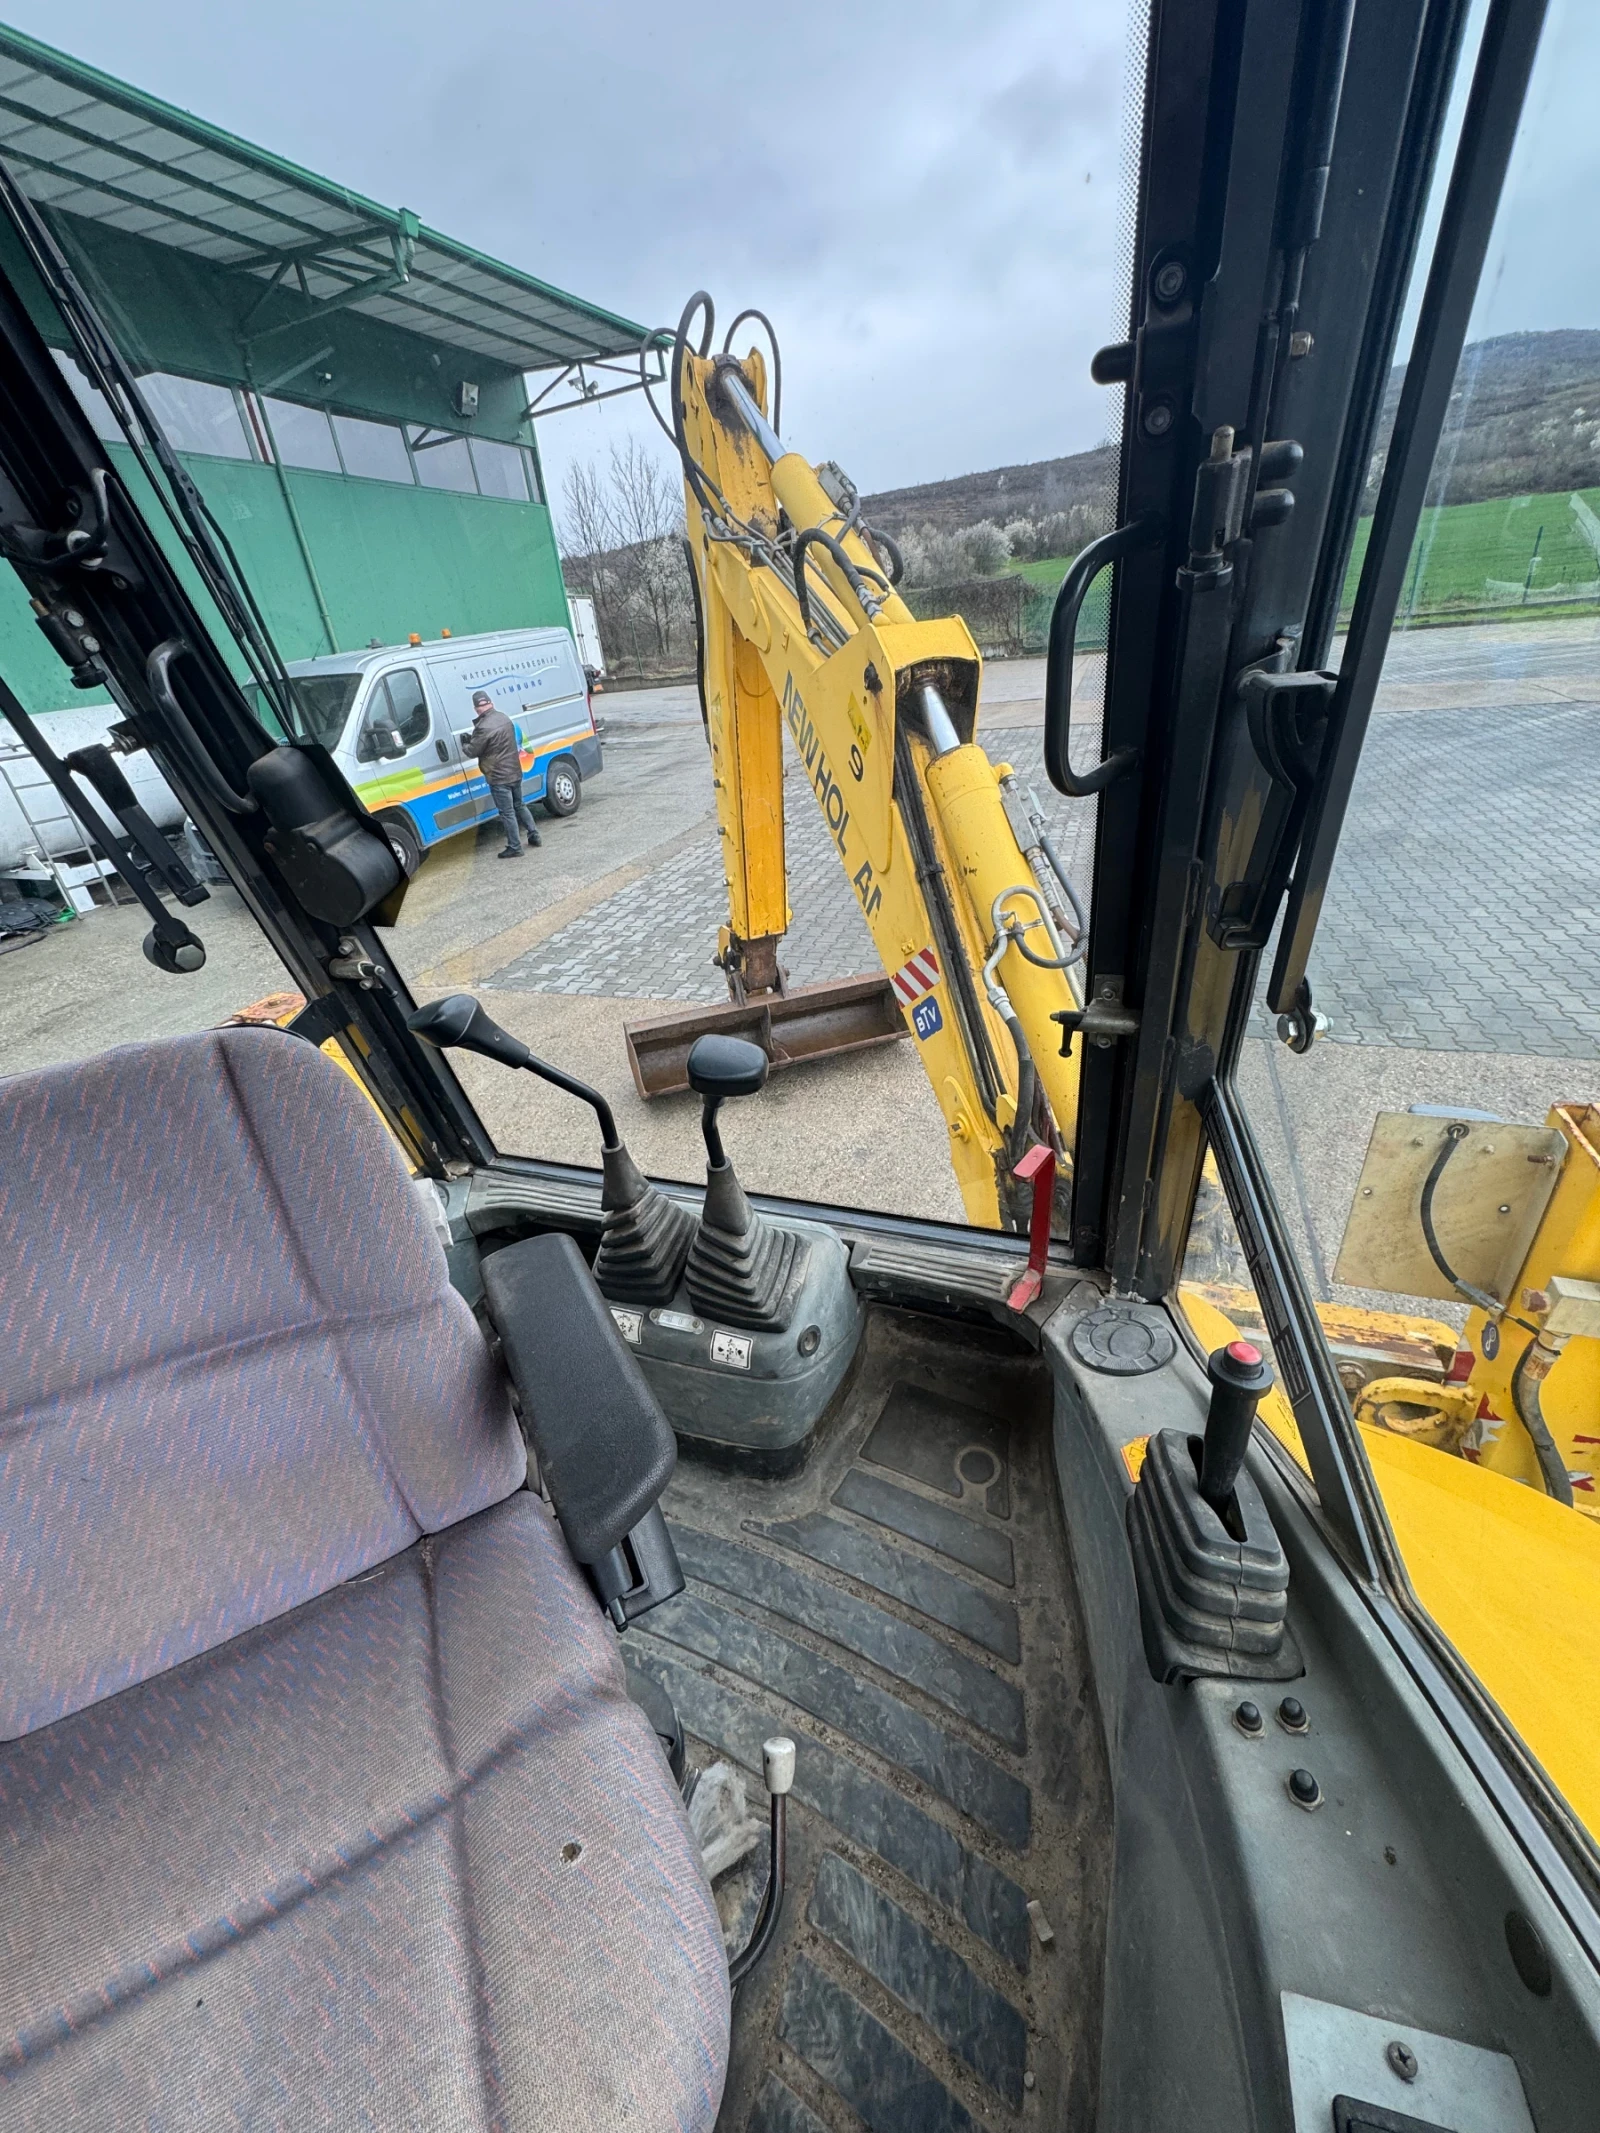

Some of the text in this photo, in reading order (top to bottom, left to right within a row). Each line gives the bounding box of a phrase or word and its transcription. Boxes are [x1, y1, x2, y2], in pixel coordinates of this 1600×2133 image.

[461, 655, 558, 681] WATERSCHAPSBEDRIJF
[495, 679, 543, 696] LIMBURG
[782, 669, 820, 771] NEW
[916, 1006, 936, 1033] BTV
